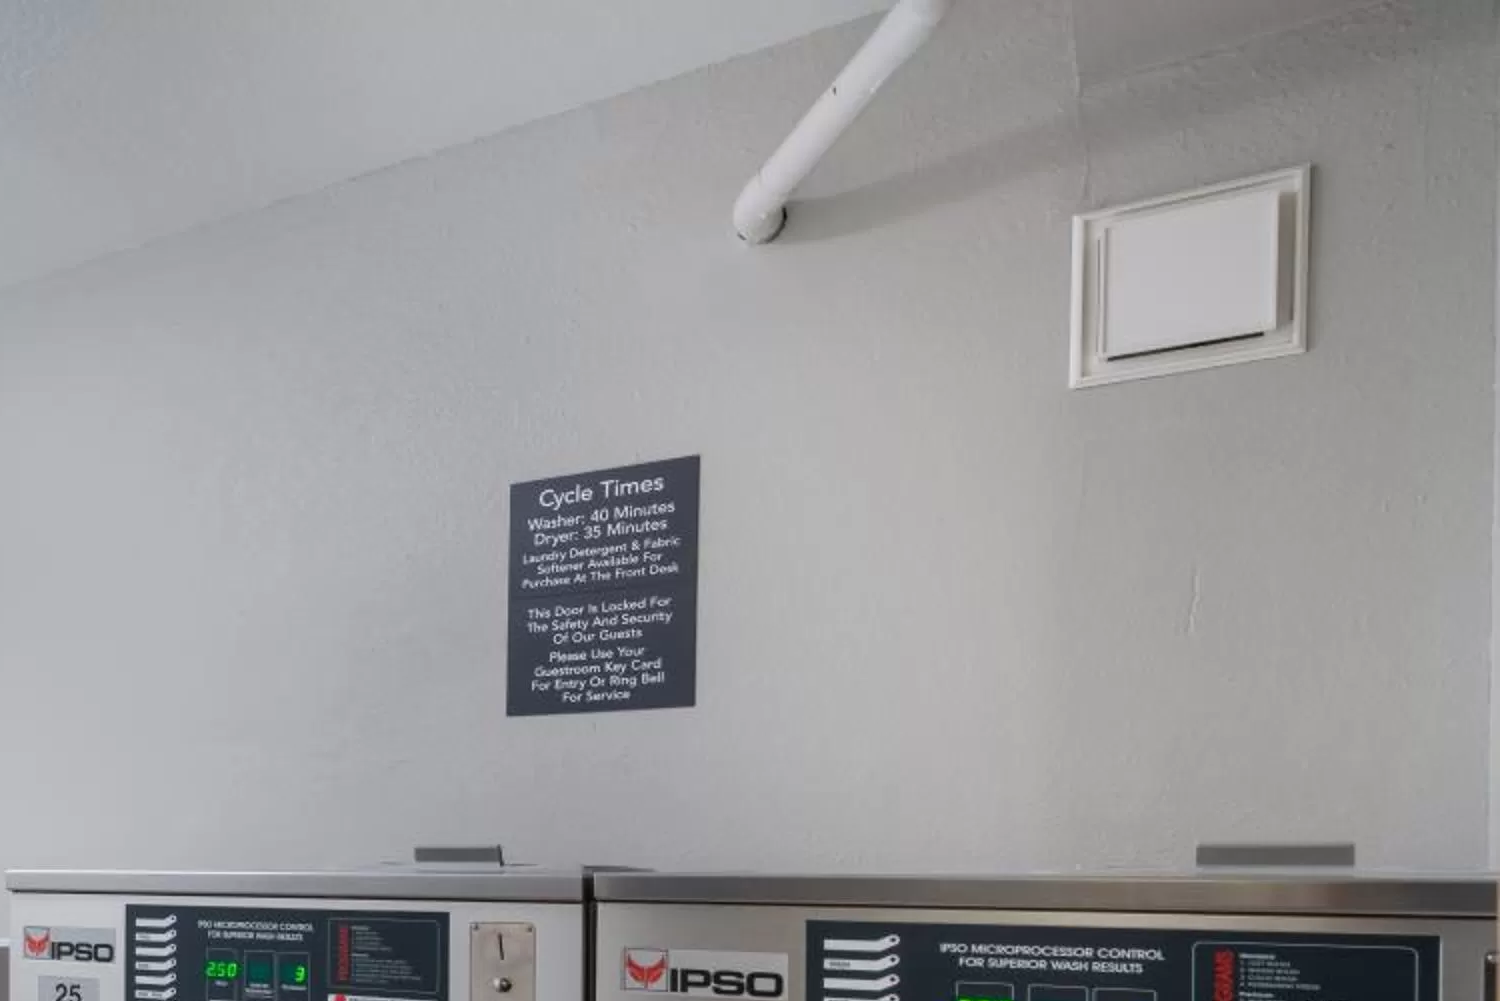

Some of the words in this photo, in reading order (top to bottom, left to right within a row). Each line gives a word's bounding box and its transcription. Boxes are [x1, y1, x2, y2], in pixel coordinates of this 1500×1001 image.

[539, 484, 593, 511] Cycle
[599, 476, 665, 499] Times
[528, 514, 585, 532] Washer:
[590, 509, 609, 523] 40
[614, 501, 676, 520] Minutes
[533, 531, 579, 548] Dryer:
[583, 525, 601, 540] 35
[607, 518, 668, 537] Minutes
[522, 550, 566, 566] Laundry
[570, 543, 627, 560] Detergent
[631, 539, 641, 551] &
[644, 536, 681, 548] Fabric
[537, 562, 583, 576] Softener
[588, 554, 639, 570] Available
[643, 552, 663, 563] For
[522, 577, 570, 590] Purchase
[574, 573, 587, 584] At
[591, 570, 611, 581] The
[615, 566, 646, 578] Front
[650, 562, 679, 574] Desk
[528, 608, 550, 619] This
[555, 605, 584, 617] Door
[588, 603, 598, 614] Is
[601, 599, 647, 613] Locked
[650, 596, 673, 608] For
[528, 622, 548, 633] The
[552, 618, 589, 632] Safety
[592, 615, 618, 627] And
[621, 611, 673, 625] Security
[552, 633, 569, 645] Of
[572, 631, 595, 643] Our
[599, 627, 643, 641] Guests
[549, 650, 587, 662] Please
[591, 648, 614, 660] Use
[617, 646, 644, 657] Your
[534, 664, 601, 678] Guestroom
[605, 661, 627, 674] Key
[631, 657, 662, 670] Card
[531, 681, 550, 692] For
[554, 677, 587, 690] Entry
[589, 675, 605, 687] Or
[609, 675, 637, 688] Ring
[641, 672, 665, 684] Bell
[562, 692, 582, 703] For
[586, 689, 631, 702] Service
[51, 942, 114, 963] IPSO
[940, 943, 969, 954] IPSO
[971, 944, 1093, 958] MICROPROCESSOR
[1097, 948, 1165, 961] CONTROL
[294, 965, 305, 983] 3
[959, 957, 985, 967] FOR
[987, 958, 1047, 970] SUPERIOR
[1050, 961, 1088, 972] WASH
[1092, 962, 1144, 974] RESULTS
[670, 968, 784, 998] IPSO
